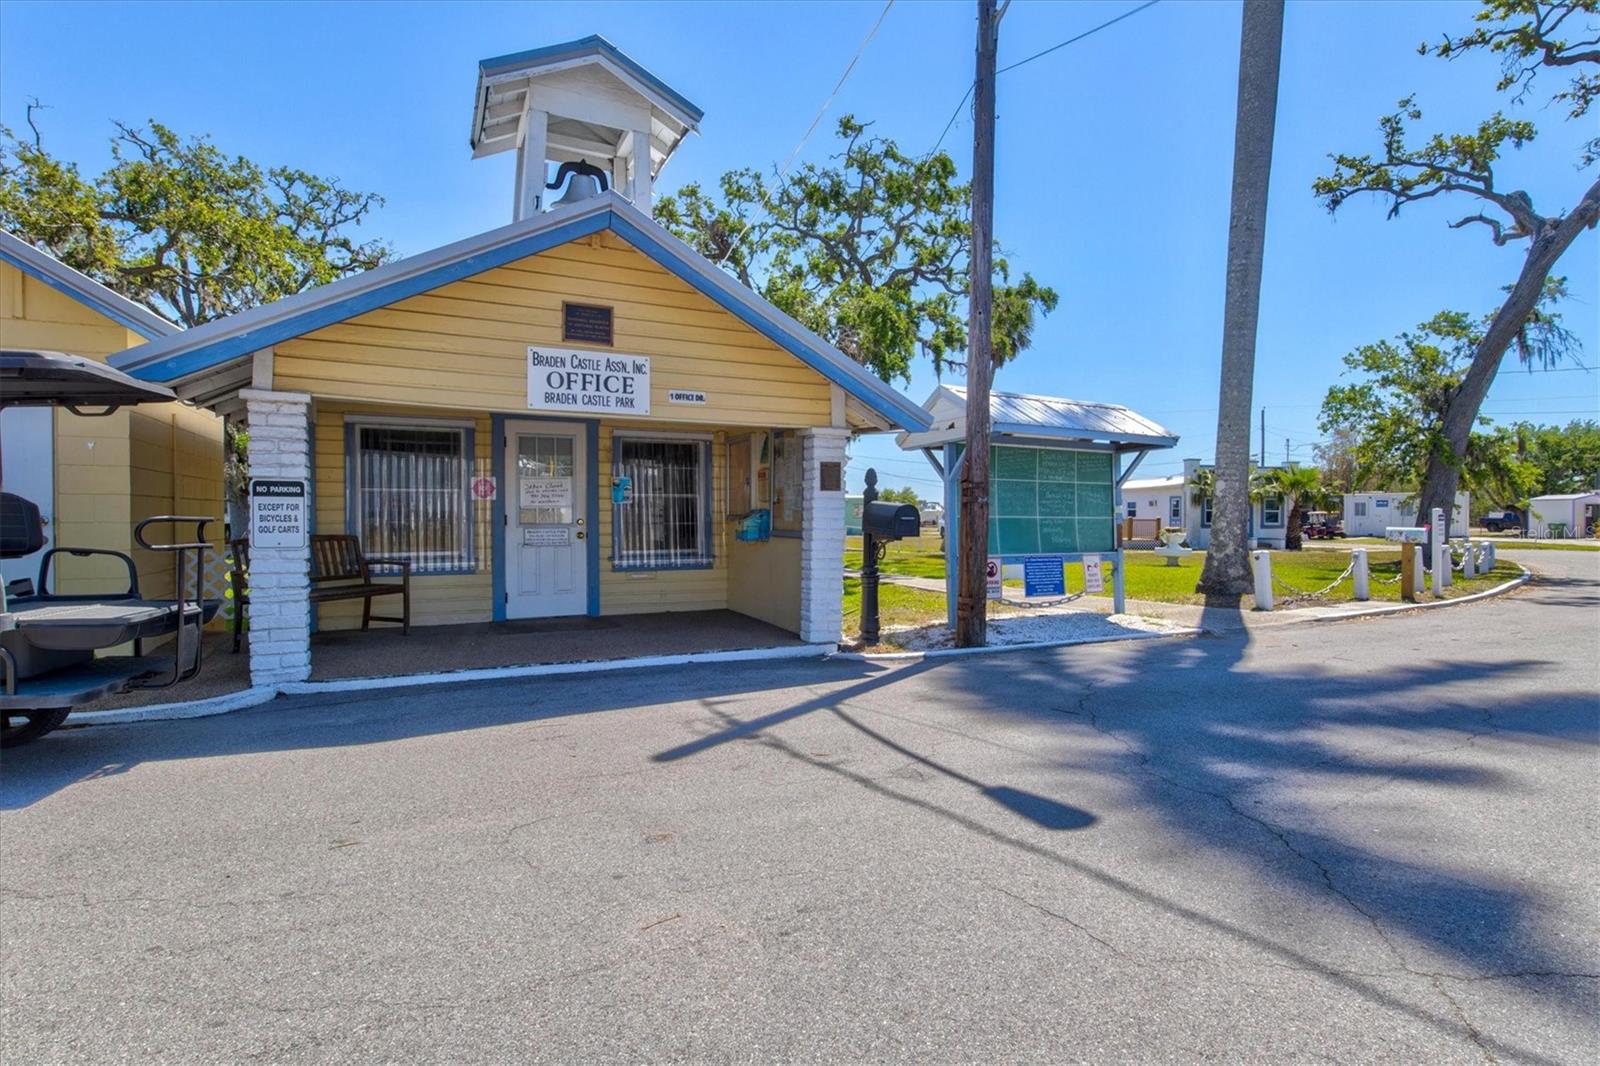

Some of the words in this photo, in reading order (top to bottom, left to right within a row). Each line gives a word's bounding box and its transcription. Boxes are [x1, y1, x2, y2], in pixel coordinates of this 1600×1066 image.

[532, 351, 566, 369] BRADEN
[570, 354, 601, 372] CASTLE
[546, 371, 635, 394] OFFICE
[544, 392, 577, 405] BRADEN
[582, 394, 612, 408] CASTLE
[615, 396, 636, 409] PARK
[674, 393, 694, 401] OFFICE
